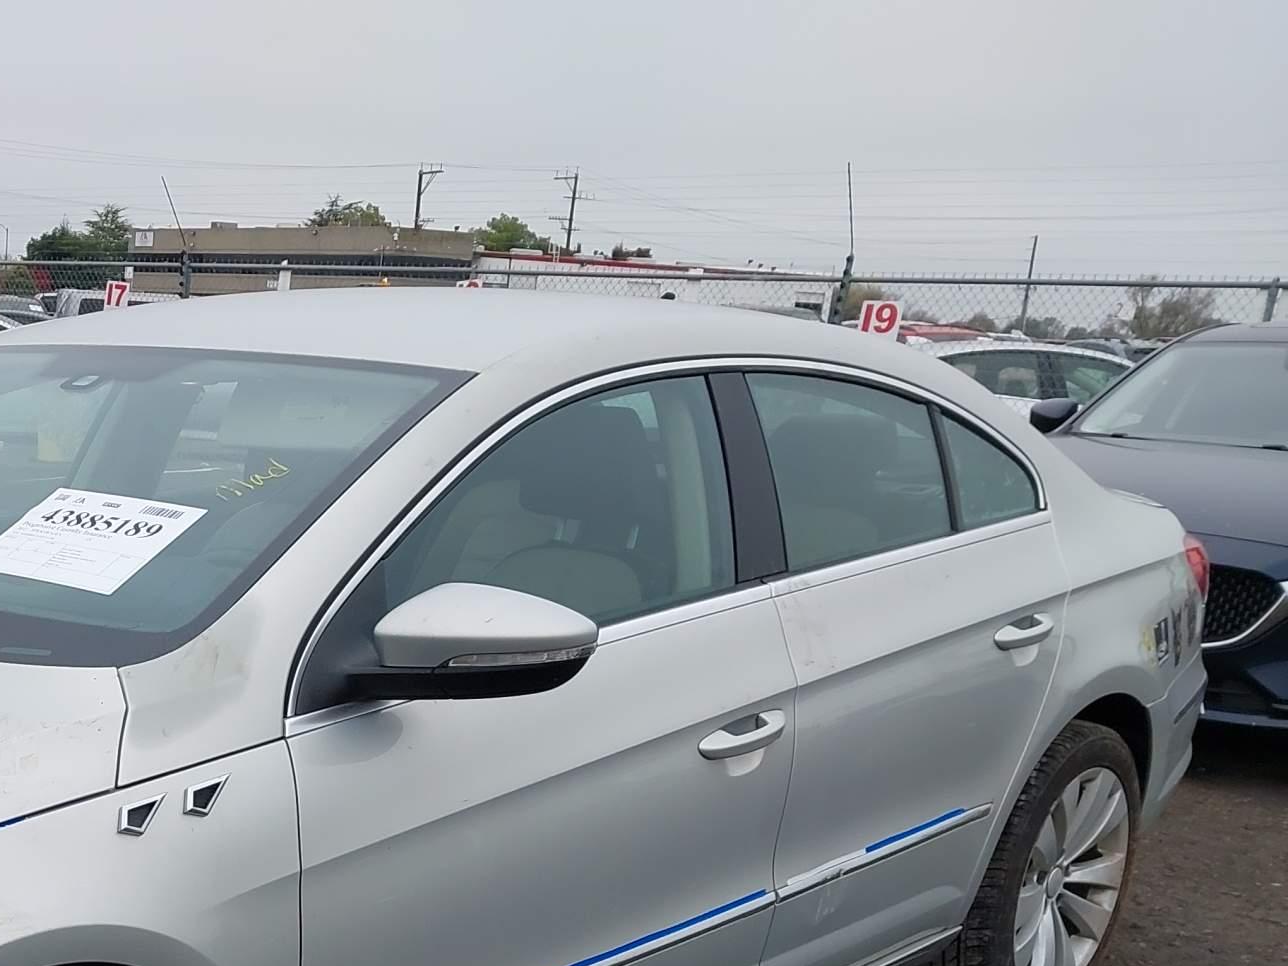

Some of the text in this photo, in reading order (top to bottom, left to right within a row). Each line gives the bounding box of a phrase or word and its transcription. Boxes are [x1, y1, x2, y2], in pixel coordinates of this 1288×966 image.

[107, 284, 128, 307] 17
[861, 303, 899, 333] 19
[41, 508, 163, 539] 43885189
